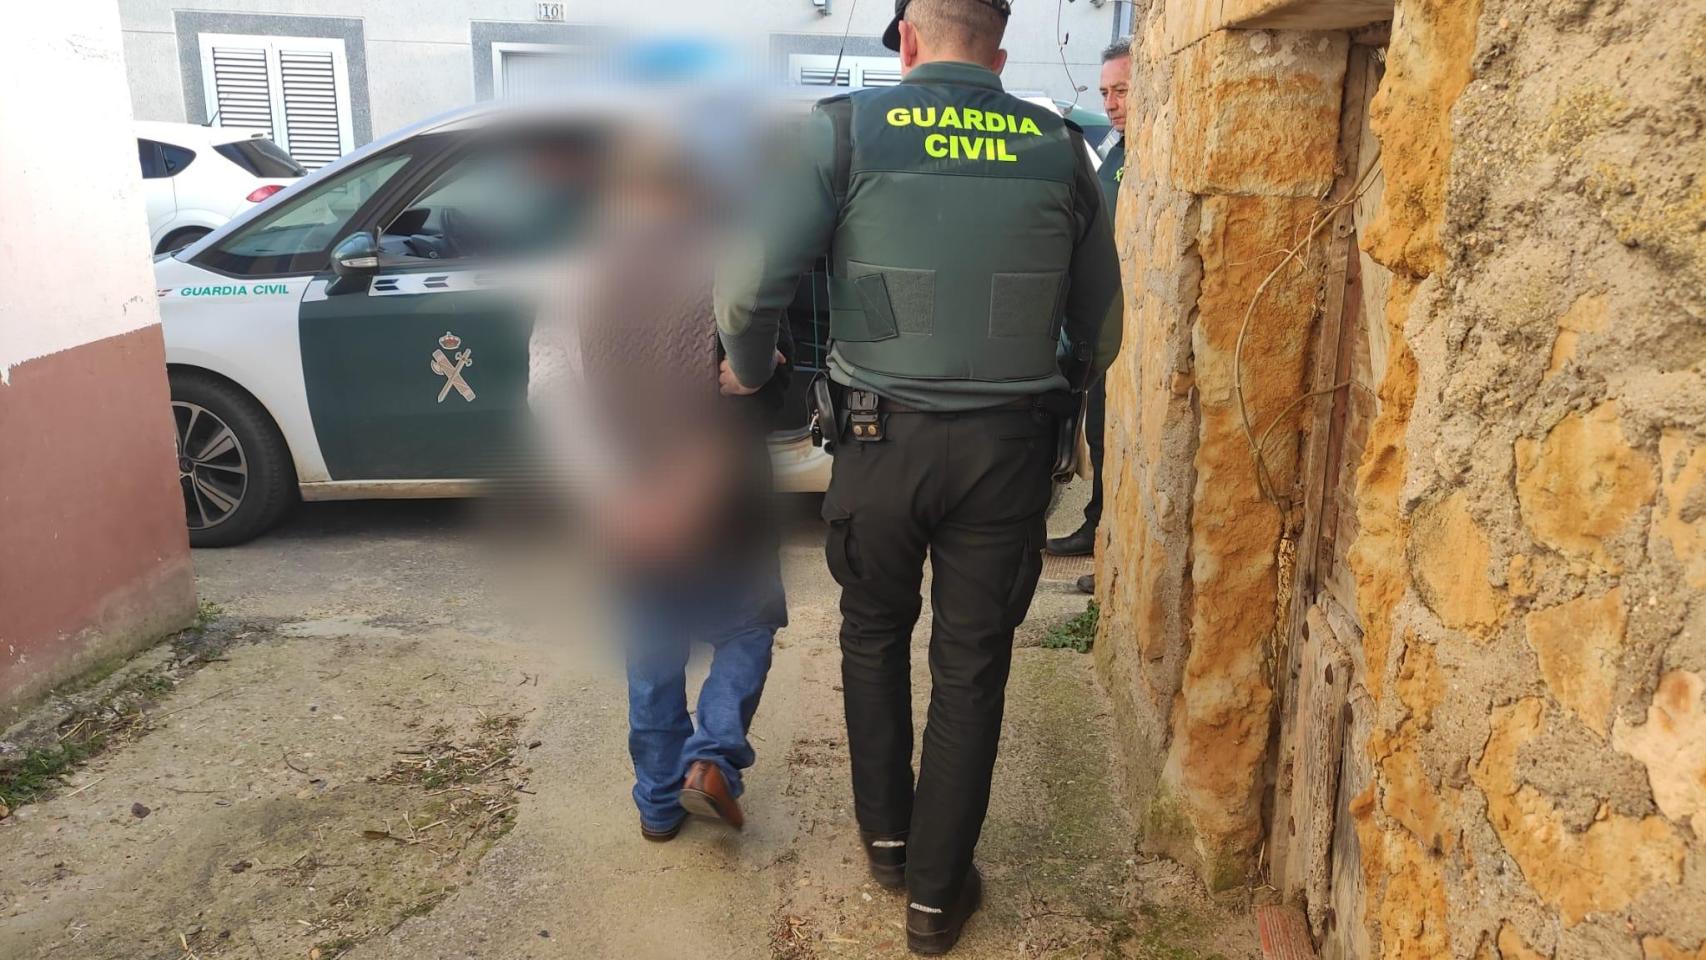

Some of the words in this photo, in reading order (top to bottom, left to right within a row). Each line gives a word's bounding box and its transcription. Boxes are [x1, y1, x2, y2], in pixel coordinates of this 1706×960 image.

[544, 6, 559, 17] 10
[886, 106, 1043, 136] GUARDIA
[924, 133, 1017, 162] CIVIL
[180, 285, 248, 297] GUARDIA
[253, 284, 289, 295] CIVIL
